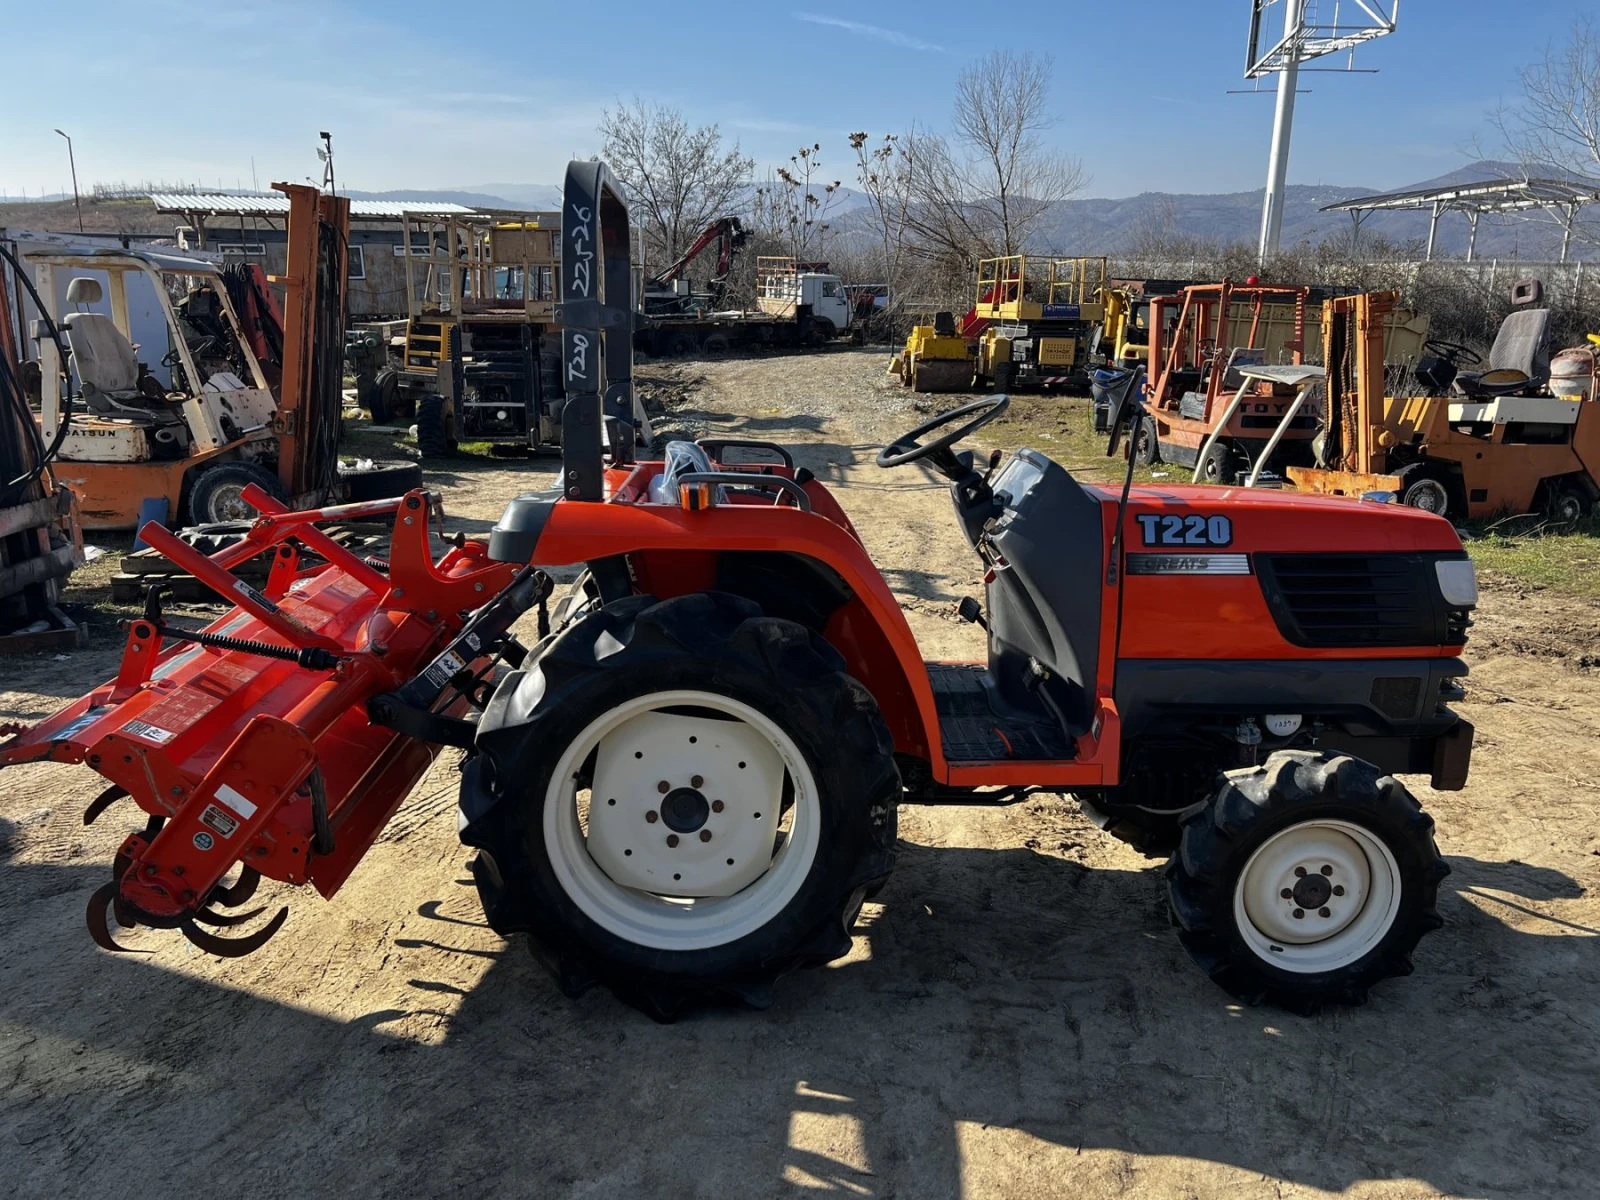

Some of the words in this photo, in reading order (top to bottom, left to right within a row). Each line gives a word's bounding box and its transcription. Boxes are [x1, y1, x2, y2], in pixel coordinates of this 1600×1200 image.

[568, 334, 589, 381] T220
[1240, 403, 1317, 414] TOYTA
[1137, 514, 1232, 545] T220
[1144, 558, 1209, 570] GREATS
